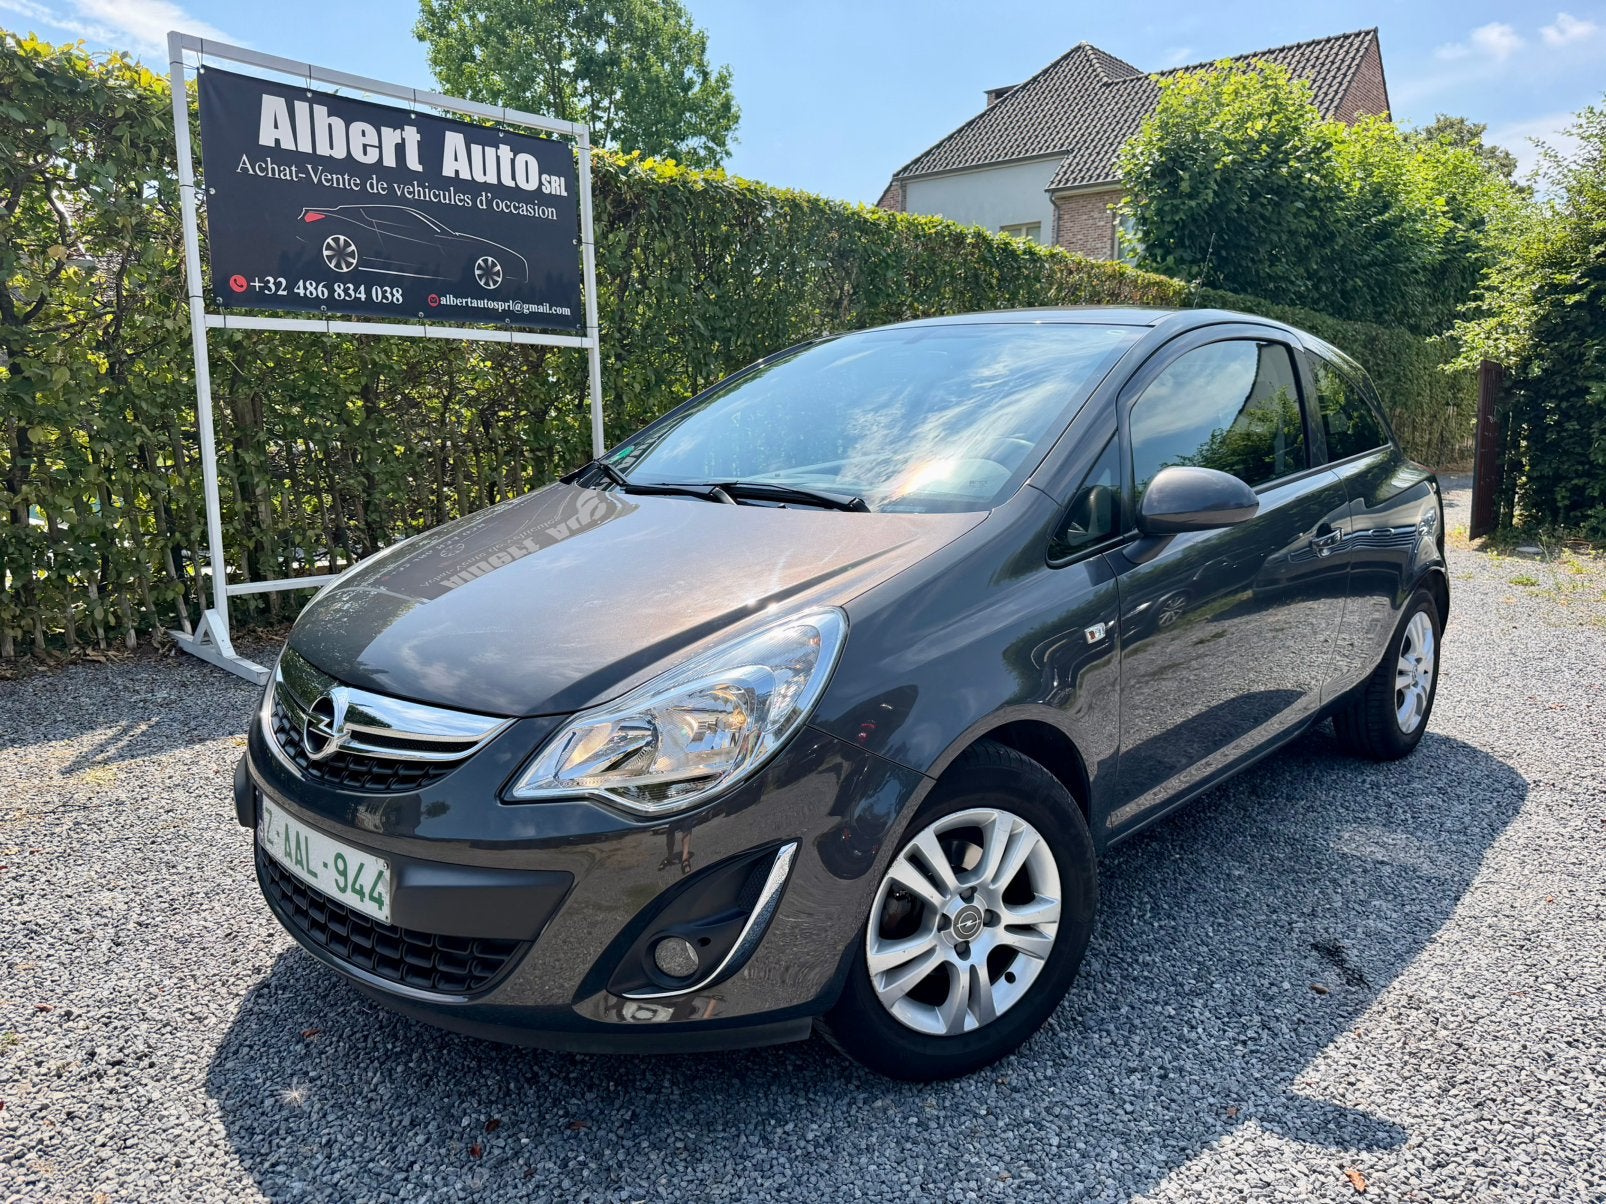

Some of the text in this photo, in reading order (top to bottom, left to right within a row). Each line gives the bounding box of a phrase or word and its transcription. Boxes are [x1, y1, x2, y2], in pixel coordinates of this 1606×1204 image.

[259, 94, 568, 197] Albert Auto SRL
[236, 154, 361, 191] Achat-Vente
[366, 174, 389, 195] de
[393, 181, 473, 208] vehicules
[250, 277, 404, 305] +32 486 834 038
[440, 294, 571, 316] albertautosprl@gmail.com
[265, 807, 385, 911] Z-AAL-944
